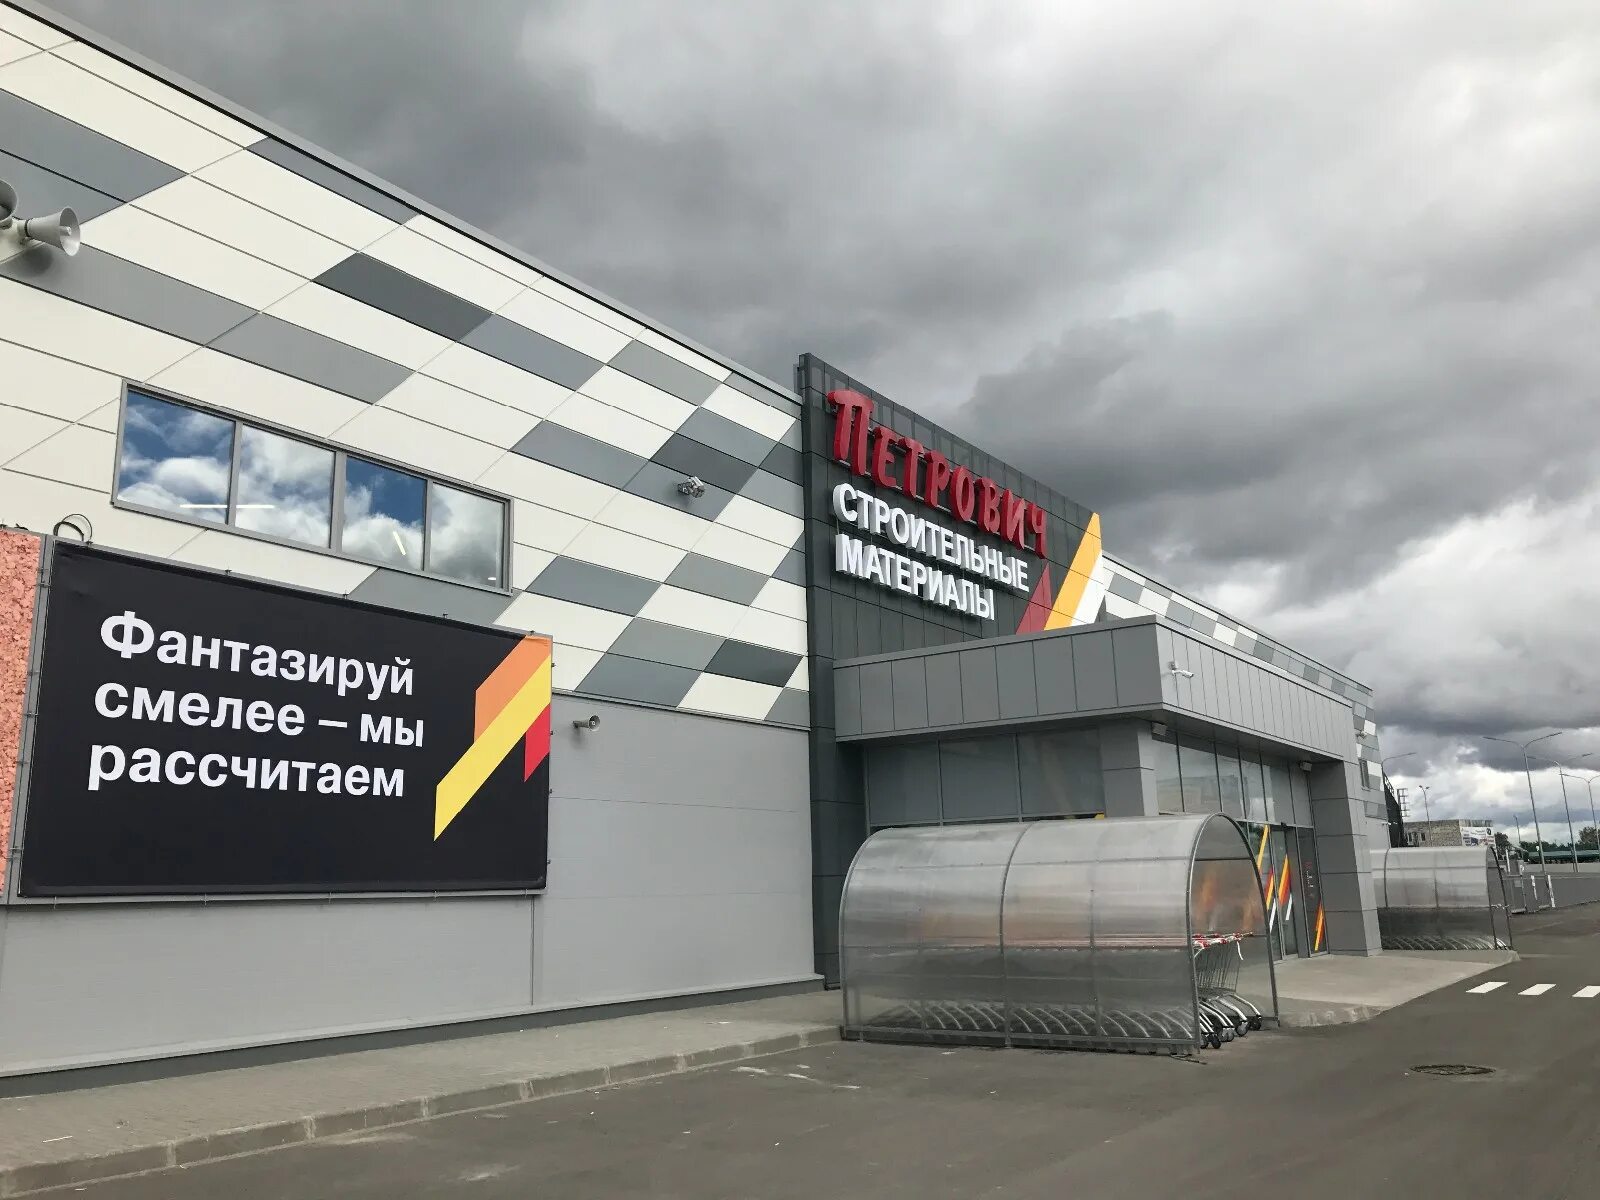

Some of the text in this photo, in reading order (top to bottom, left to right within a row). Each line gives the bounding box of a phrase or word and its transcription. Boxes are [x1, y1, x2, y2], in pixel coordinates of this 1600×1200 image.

[833, 483, 1029, 592] СТРОИТЕЛЬНЫЕ
[835, 534, 994, 620] МАТЕРИАЛЫ
[100, 611, 414, 700] Фантазируй
[94, 681, 305, 736] смелее
[359, 712, 425, 747] мы
[88, 743, 404, 797] рассчитаем
